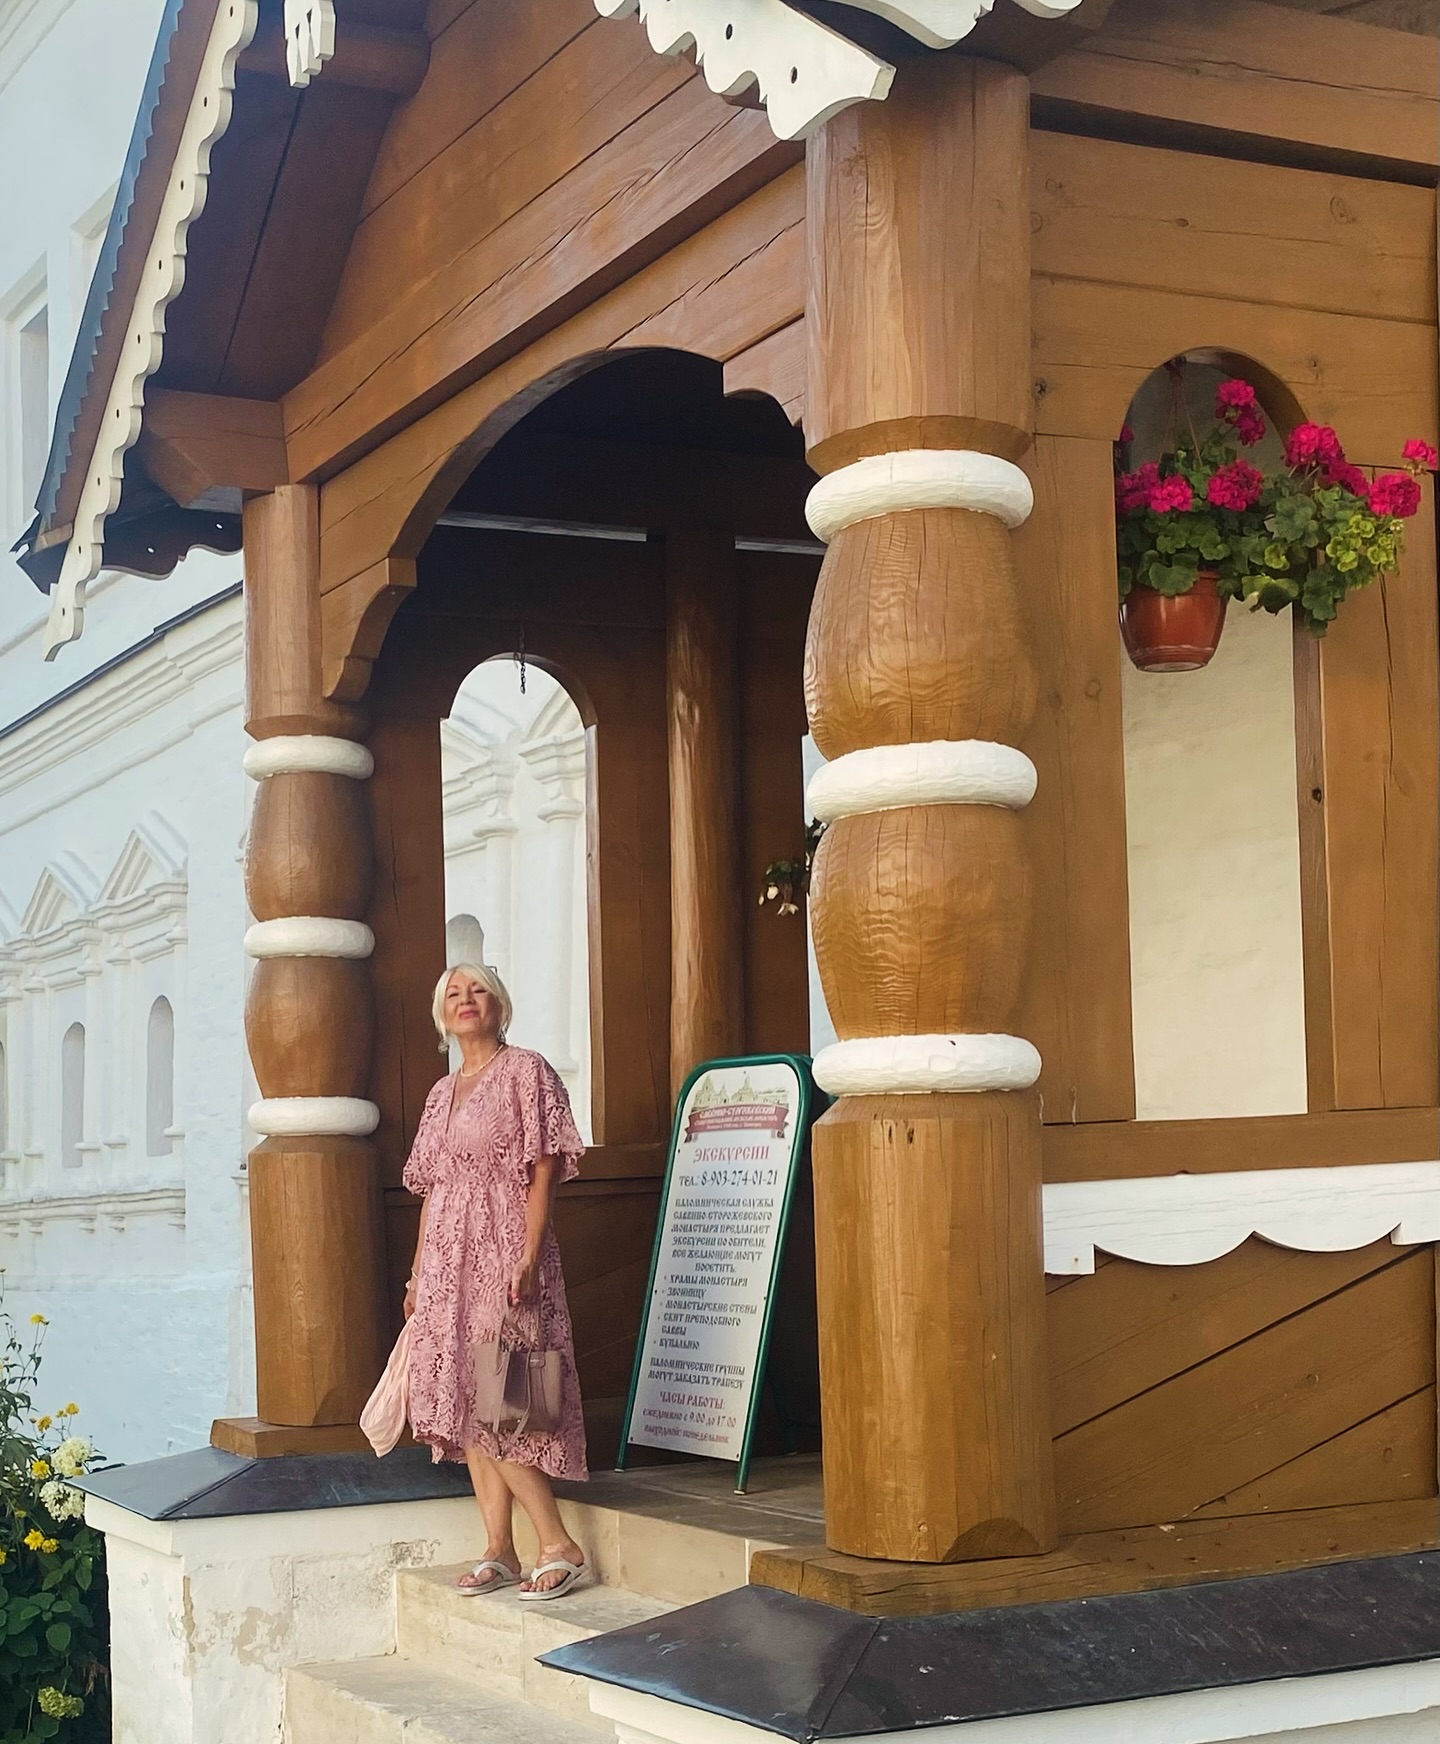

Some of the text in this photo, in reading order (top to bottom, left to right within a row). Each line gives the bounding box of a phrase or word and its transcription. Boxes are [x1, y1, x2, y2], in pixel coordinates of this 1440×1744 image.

[693, 1146, 770, 1165] ЭКСКУРСИИ
[701, 1169, 779, 1187] 8-903-274-01-21
[675, 1197, 774, 1209] ПАЛОМНИЧЕСКАЯ СЛУЖБА
[671, 1223, 771, 1235] МОНАСТЫРЯ ПРЕДЛАГАЕТ
[717, 1237, 728, 1247] ПО
[672, 1248, 763, 1263] ВСЕ ЖЕЛАЮЩИЕ МОГУТ
[670, 1274, 748, 1287] ХРАМЫ МОНАСТЫРЯ
[665, 1300, 758, 1315] МОНАСТЫРСКИЕ СТЕНЫ
[663, 1312, 741, 1327] СКИТ ПРЕПОДОБНОГО
[661, 1325, 687, 1336] САВВЫ
[649, 1357, 746, 1376] ПАЛОМНИЧЕСКИЕ ГРУППЫ
[647, 1370, 674, 1383] МОГУТ
[673, 1372, 711, 1385] ЗАКАЗАТЬ
[660, 1391, 686, 1405] ЧАСЫ
[716, 1415, 737, 1428] 1700
